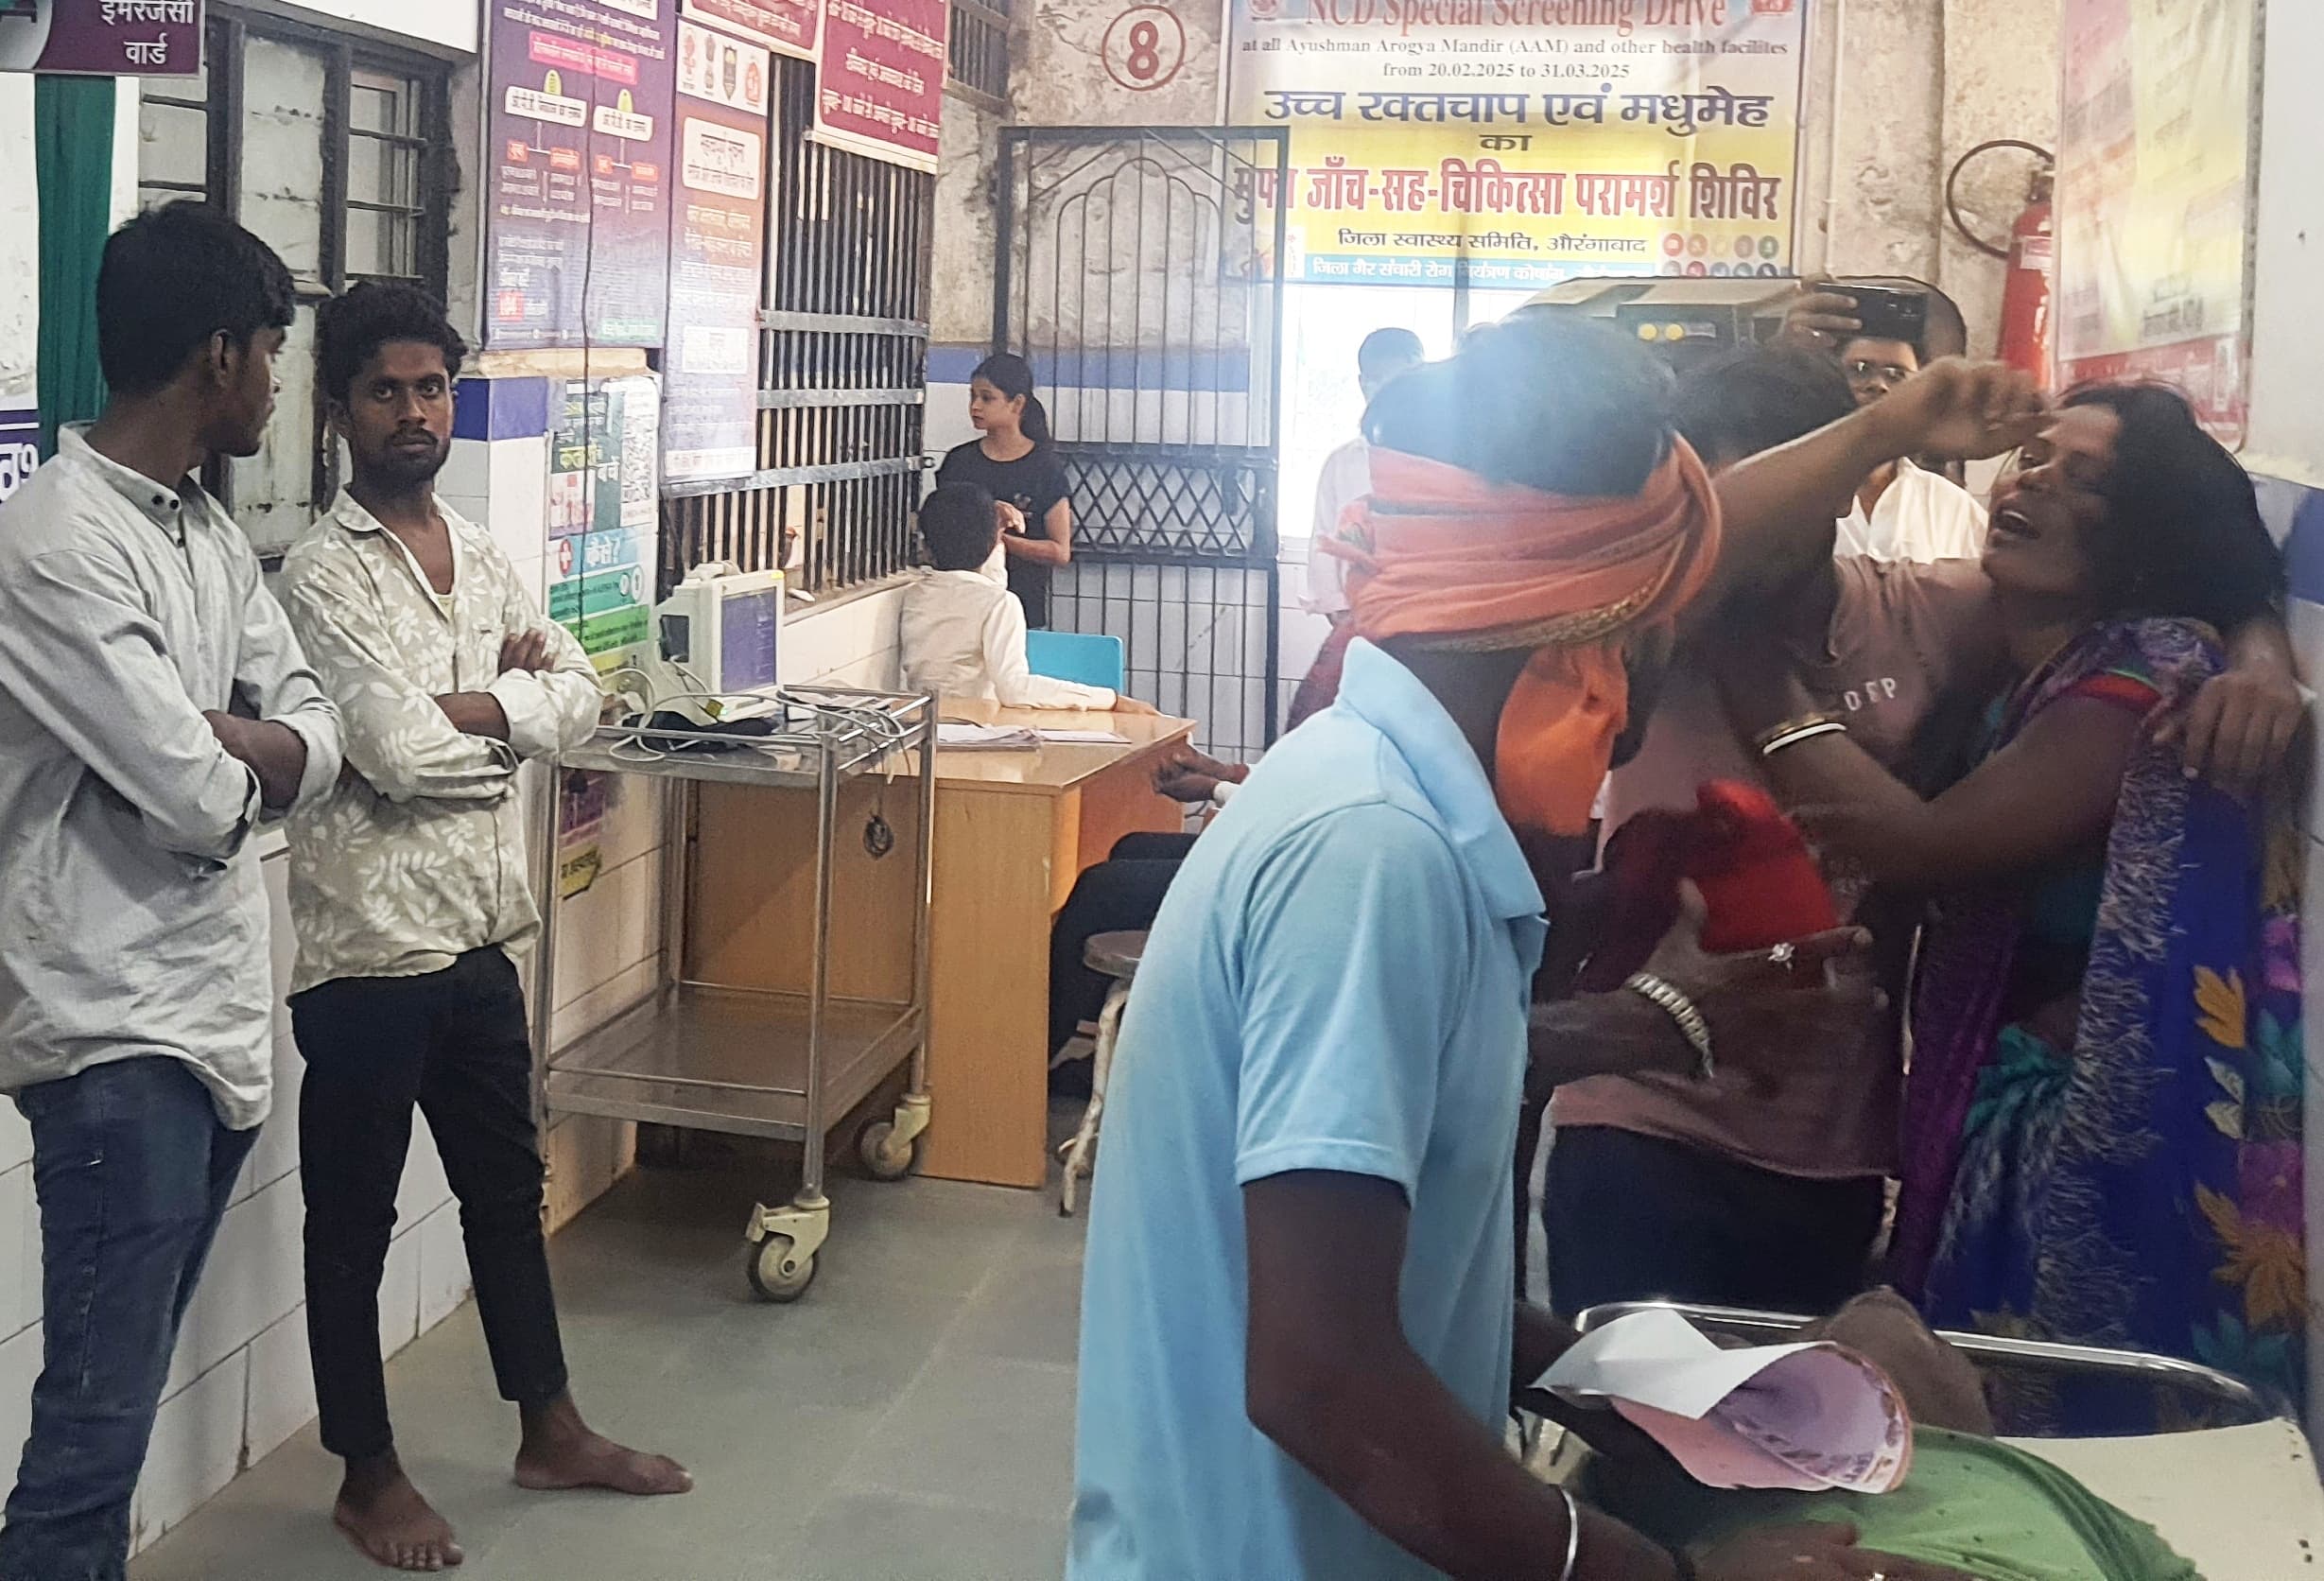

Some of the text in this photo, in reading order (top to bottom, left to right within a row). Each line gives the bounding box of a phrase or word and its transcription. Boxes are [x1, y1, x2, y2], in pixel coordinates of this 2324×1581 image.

[1306, 0, 1726, 38] NCD Special Screening Drive
[124, 32, 168, 65] वार्ड
[1127, 20, 1160, 80] 8
[1241, 41, 1258, 52] at
[1261, 38, 1281, 52] all
[1287, 39, 1371, 55] Ayushman
[1377, 39, 1435, 55] Arogya
[1441, 39, 1504, 53] Mandir
[1509, 39, 1569, 55] (AAM)
[1573, 39, 1604, 54] and
[1610, 39, 1656, 54] other
[1662, 39, 1715, 54] health
[1383, 62, 1631, 78] from 20.02.2025 to 31.03.2025
[1263, 82, 1776, 138] उच्च रक्तचाप एवं मधुमेह
[1478, 133, 1534, 152] का
[1575, 159, 1680, 218] परामर्श
[1689, 162, 1782, 220] शिविर
[1338, 228, 1387, 247] जिला
[1393, 233, 1463, 249] स्वास्थ्य
[1546, 233, 1647, 253] औरंगाबाद
[1311, 256, 1350, 276] जिला
